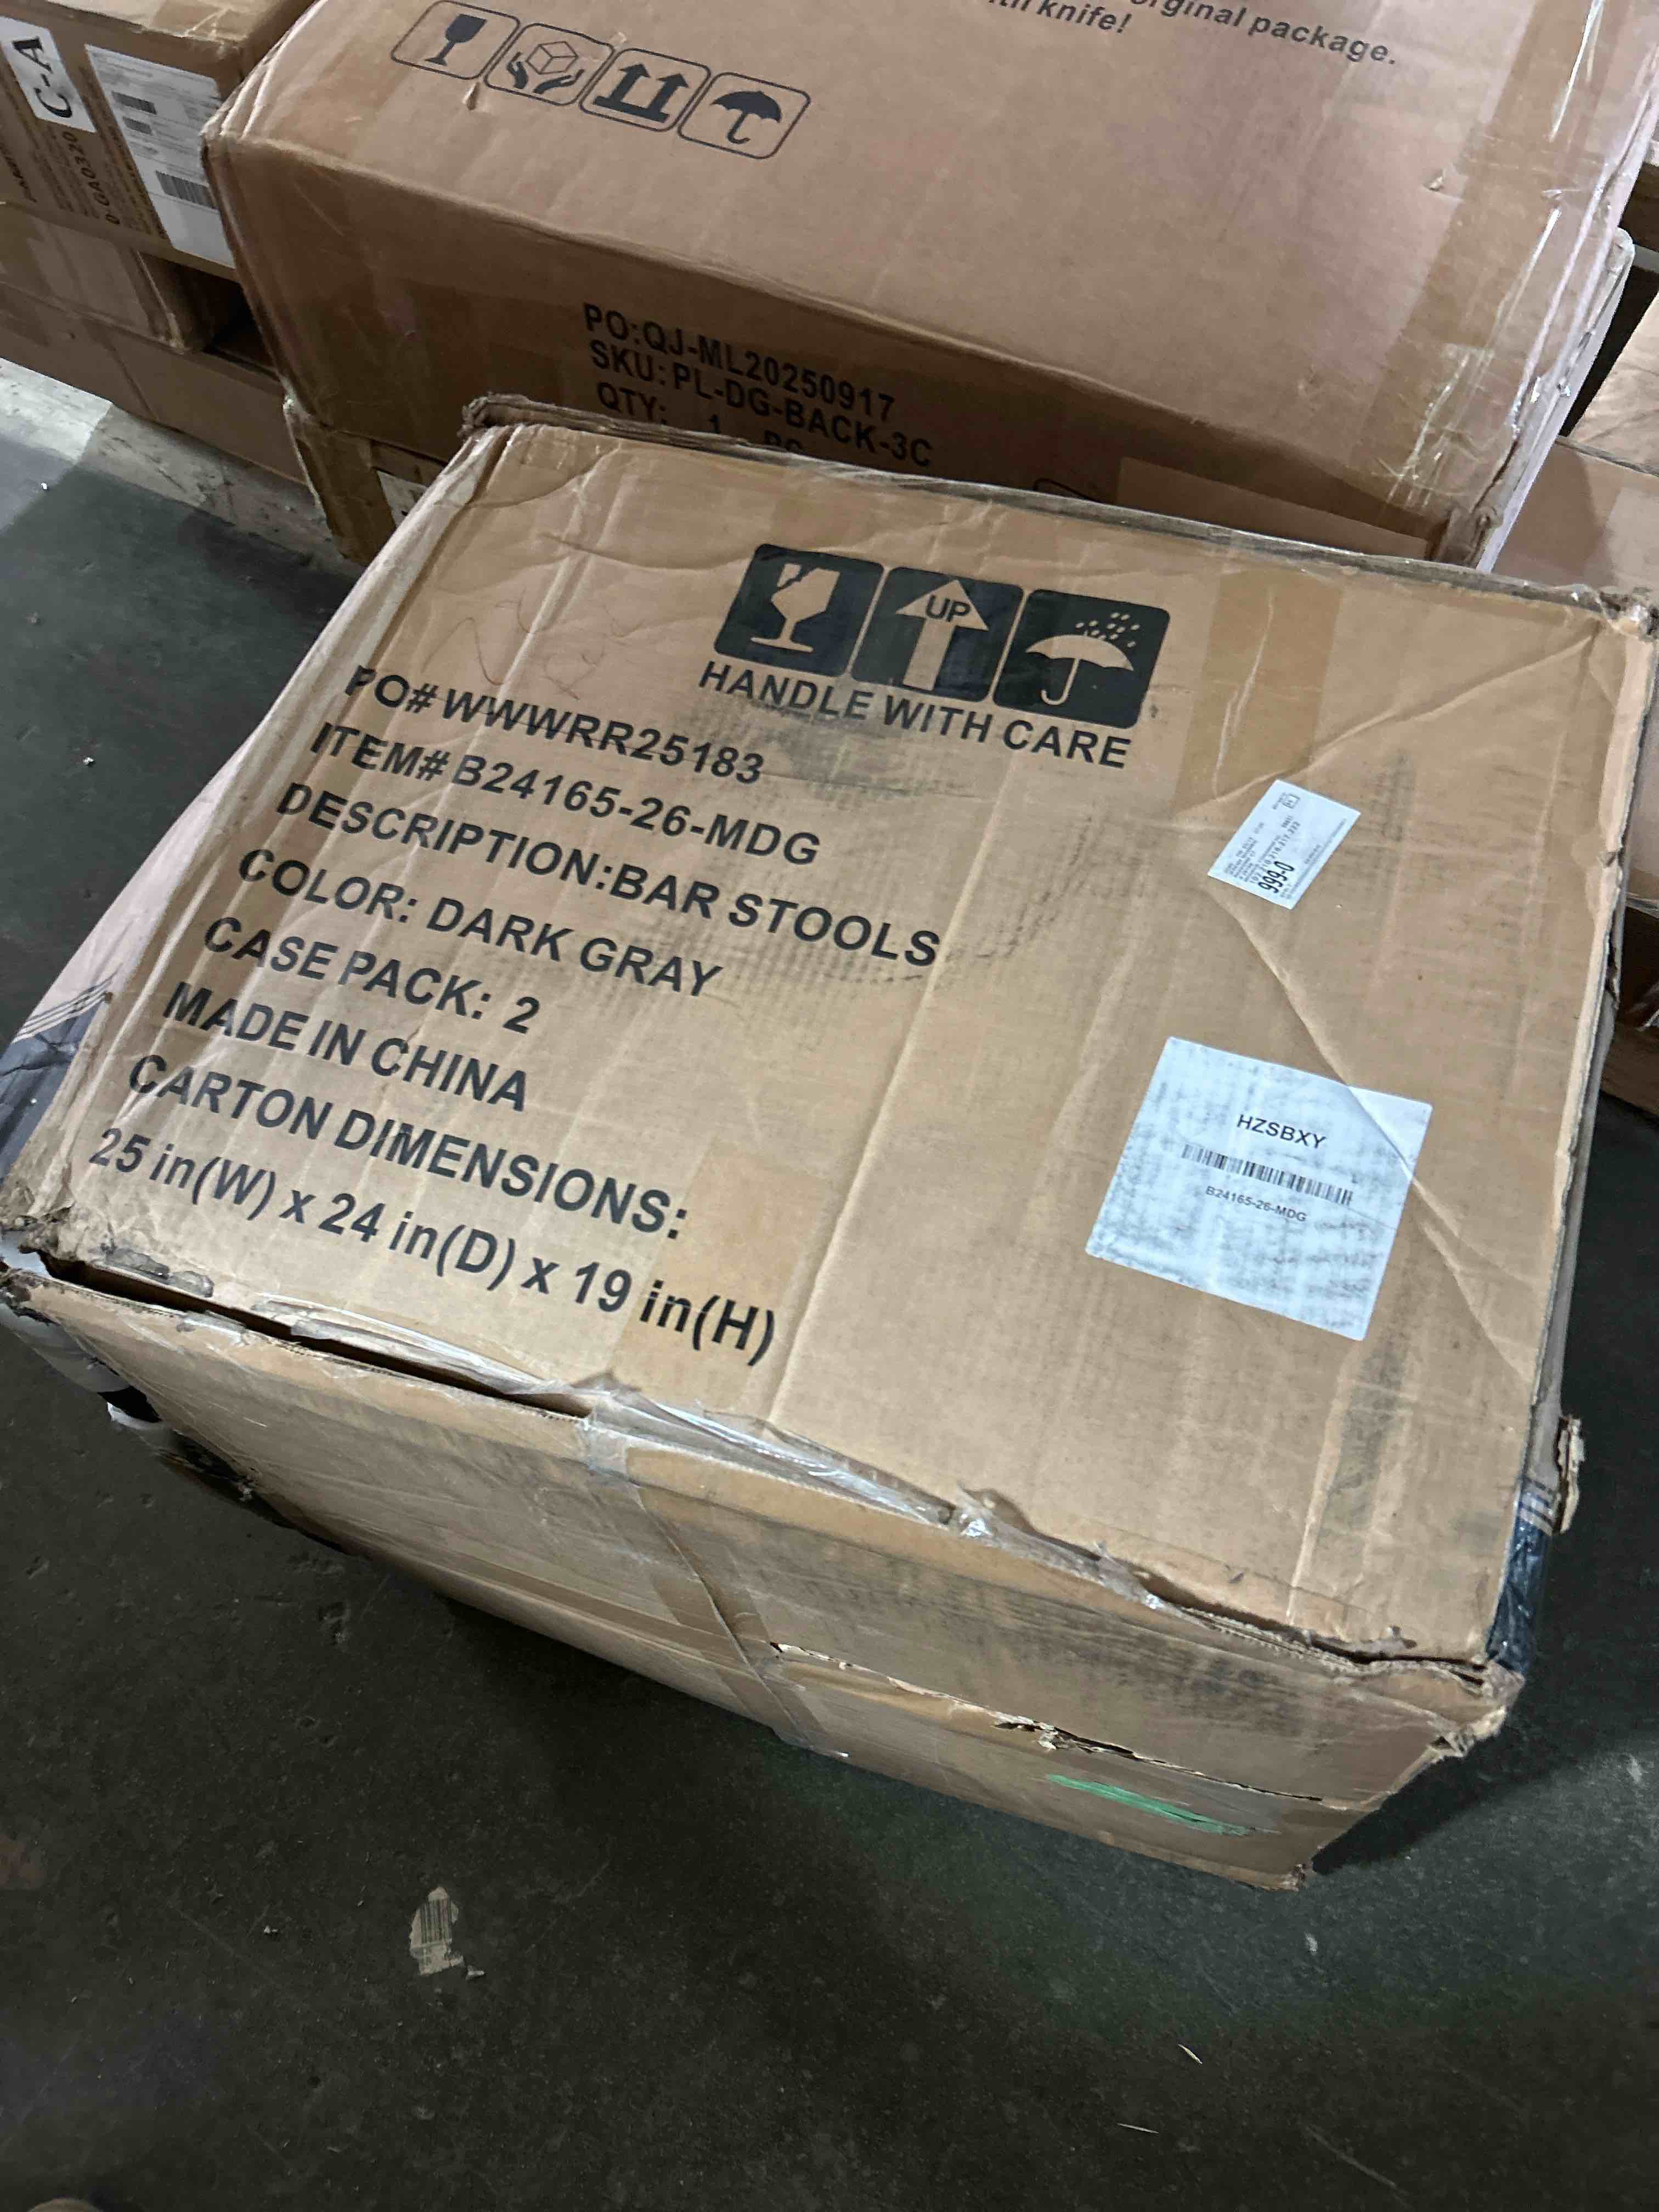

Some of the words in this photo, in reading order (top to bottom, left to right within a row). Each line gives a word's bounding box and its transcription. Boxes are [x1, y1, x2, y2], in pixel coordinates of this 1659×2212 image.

[1036, 0, 1132, 33] knife!
[1248, 17, 1396, 65] package.
[12, 36, 72, 118] C-A
[583, 303, 895, 422] PO:QJ-ML20250917
[589, 339, 932, 467] SKU:PL-DG-BACK-3C
[597, 382, 667, 425] QTY:
[925, 594, 972, 624] UP
[344, 665, 438, 714] PO#
[442, 688, 764, 784] WWWRR25183
[698, 661, 874, 721] HANDLE
[883, 695, 993, 743] WITH
[1003, 719, 1132, 769] CARE
[310, 722, 450, 781] ITEM#
[452, 755, 820, 865] B24165-26-MDG
[239, 849, 419, 923] COLOR:
[426, 897, 574, 962] DARK
[579, 937, 723, 997] GRAY
[729, 893, 941, 967] STOOLS
[1257, 861, 1295, 894] 999-0
[204, 917, 338, 980] CASE
[338, 950, 493, 1020] PACK:
[503, 996, 541, 1034] 2
[162, 981, 309, 1051] MADE
[307, 1022, 367, 1066] IN
[371, 1037, 528, 1113] CHINA
[128, 1054, 332, 1140] CARTON
[334, 1109, 689, 1240] DIMENSIONS:
[1237, 1114, 1327, 1149] HZSBXY
[89, 1127, 152, 1173] 25
[150, 1143, 276, 1221] in(W)
[280, 1189, 318, 1224] x
[318, 1192, 386, 1243] 24
[389, 1210, 516, 1291] in(D)
[521, 1256, 560, 1295] x
[574, 1261, 633, 1313] 19
[639, 1279, 776, 1367] in(H)
[1205, 1186, 1307, 1222] B24165-26-MDG
